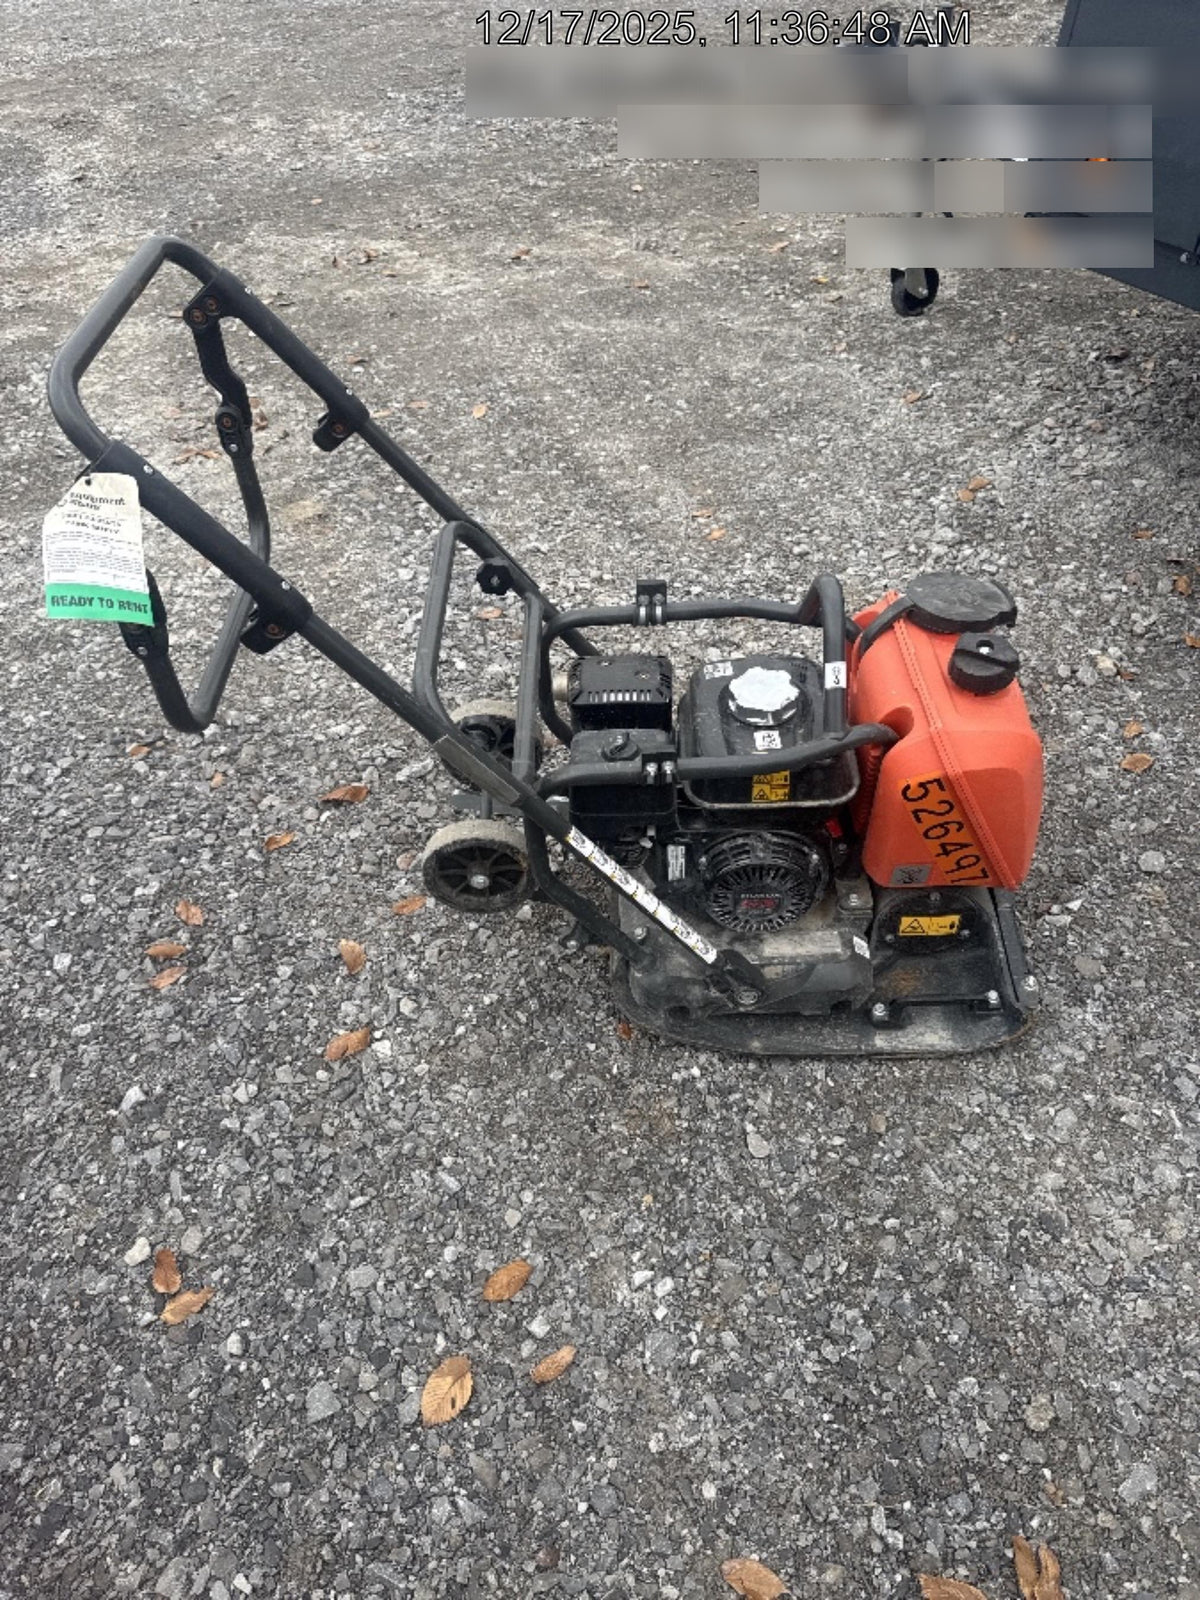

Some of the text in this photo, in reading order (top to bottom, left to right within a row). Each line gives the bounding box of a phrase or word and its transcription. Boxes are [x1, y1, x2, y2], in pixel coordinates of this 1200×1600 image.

[51, 595, 149, 614] READY TO RENT
[901, 778, 989, 884] 526497
